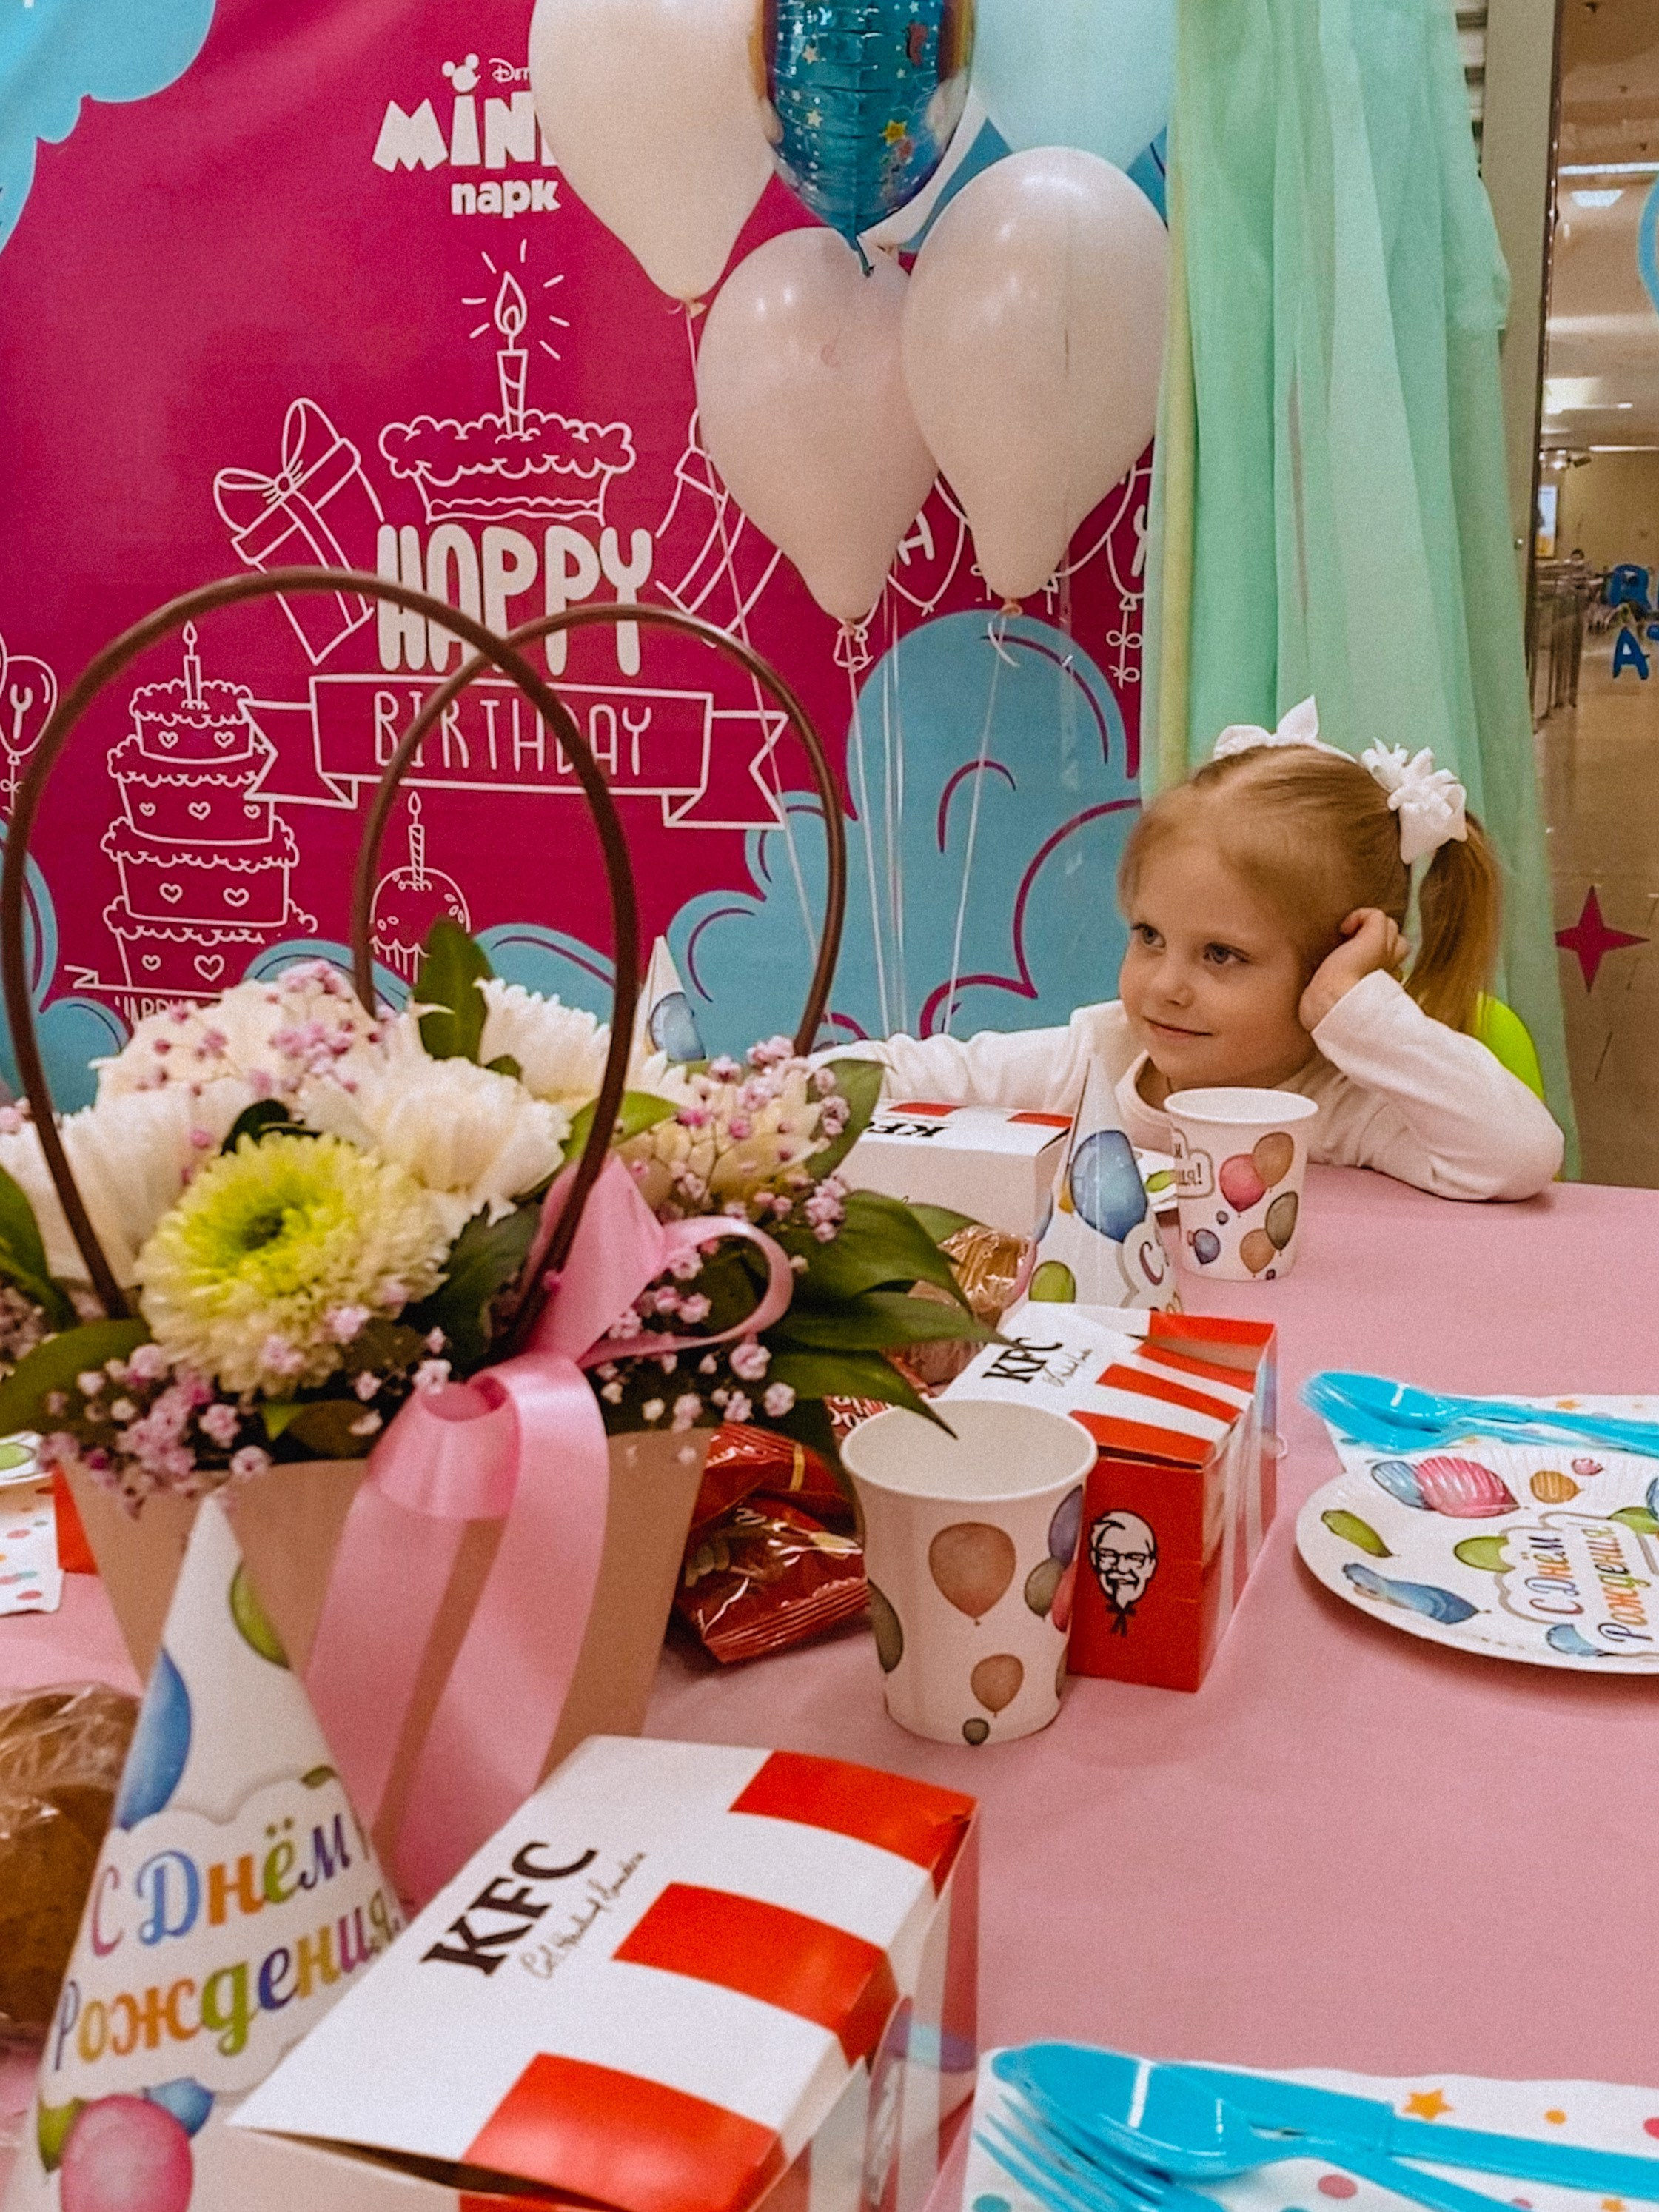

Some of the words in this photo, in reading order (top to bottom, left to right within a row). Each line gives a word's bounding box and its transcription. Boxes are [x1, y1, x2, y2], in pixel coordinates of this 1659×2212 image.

[376, 523, 653, 677] HAPPY
[374, 690, 652, 776] BIRTHDAY
[981, 1336, 1064, 1384] KFC
[91, 1865, 121, 1957] С
[136, 1814, 352, 1946] Днём
[420, 1840, 599, 1977] KFC
